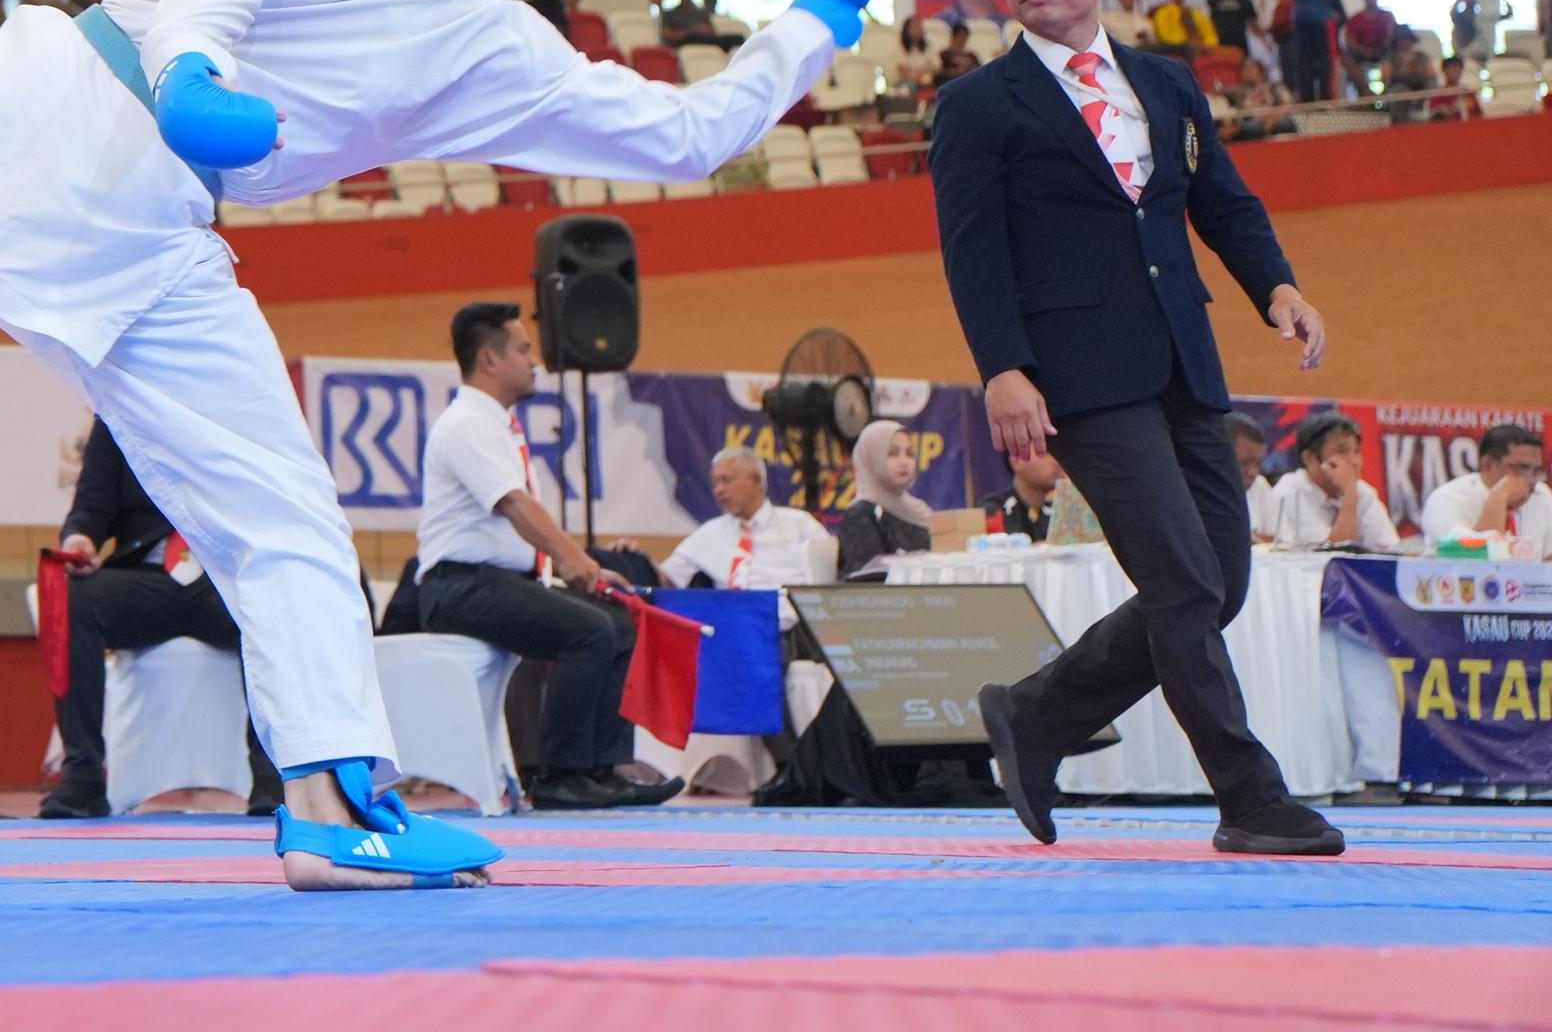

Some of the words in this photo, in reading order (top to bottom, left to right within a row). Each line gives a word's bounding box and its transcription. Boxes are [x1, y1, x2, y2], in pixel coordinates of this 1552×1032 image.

[1376, 405, 1476, 427] KEJUARAAN
[448, 387, 602, 500] RI
[1463, 614, 1510, 644] KASAU
